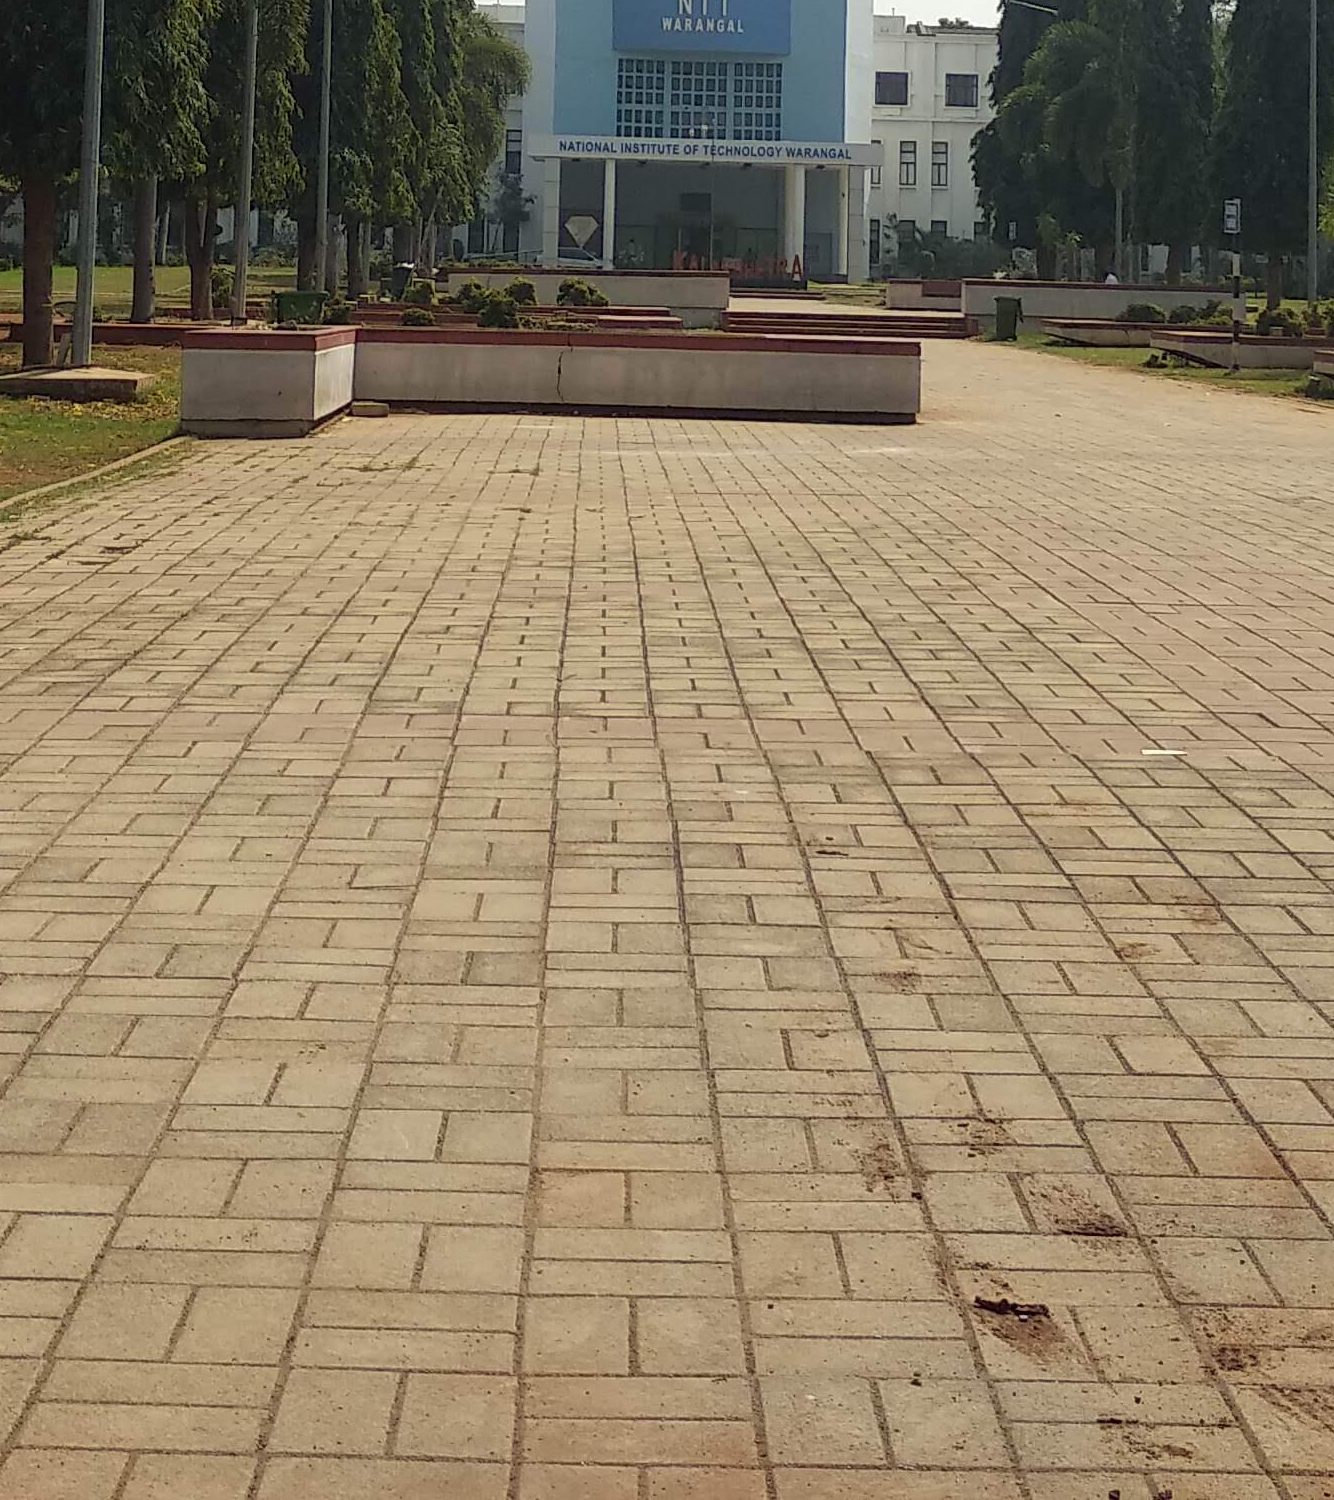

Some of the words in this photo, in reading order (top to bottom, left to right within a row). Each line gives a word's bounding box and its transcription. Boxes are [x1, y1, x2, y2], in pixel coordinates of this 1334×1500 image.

[662, 17, 744, 34] WARANGAL
[559, 140, 617, 154] NATIONAL
[620, 142, 680, 155] INSTITUTE
[683, 144, 699, 155] OF
[703, 145, 783, 158] TECHNOLOGY
[785, 147, 852, 160] WARANGAL
